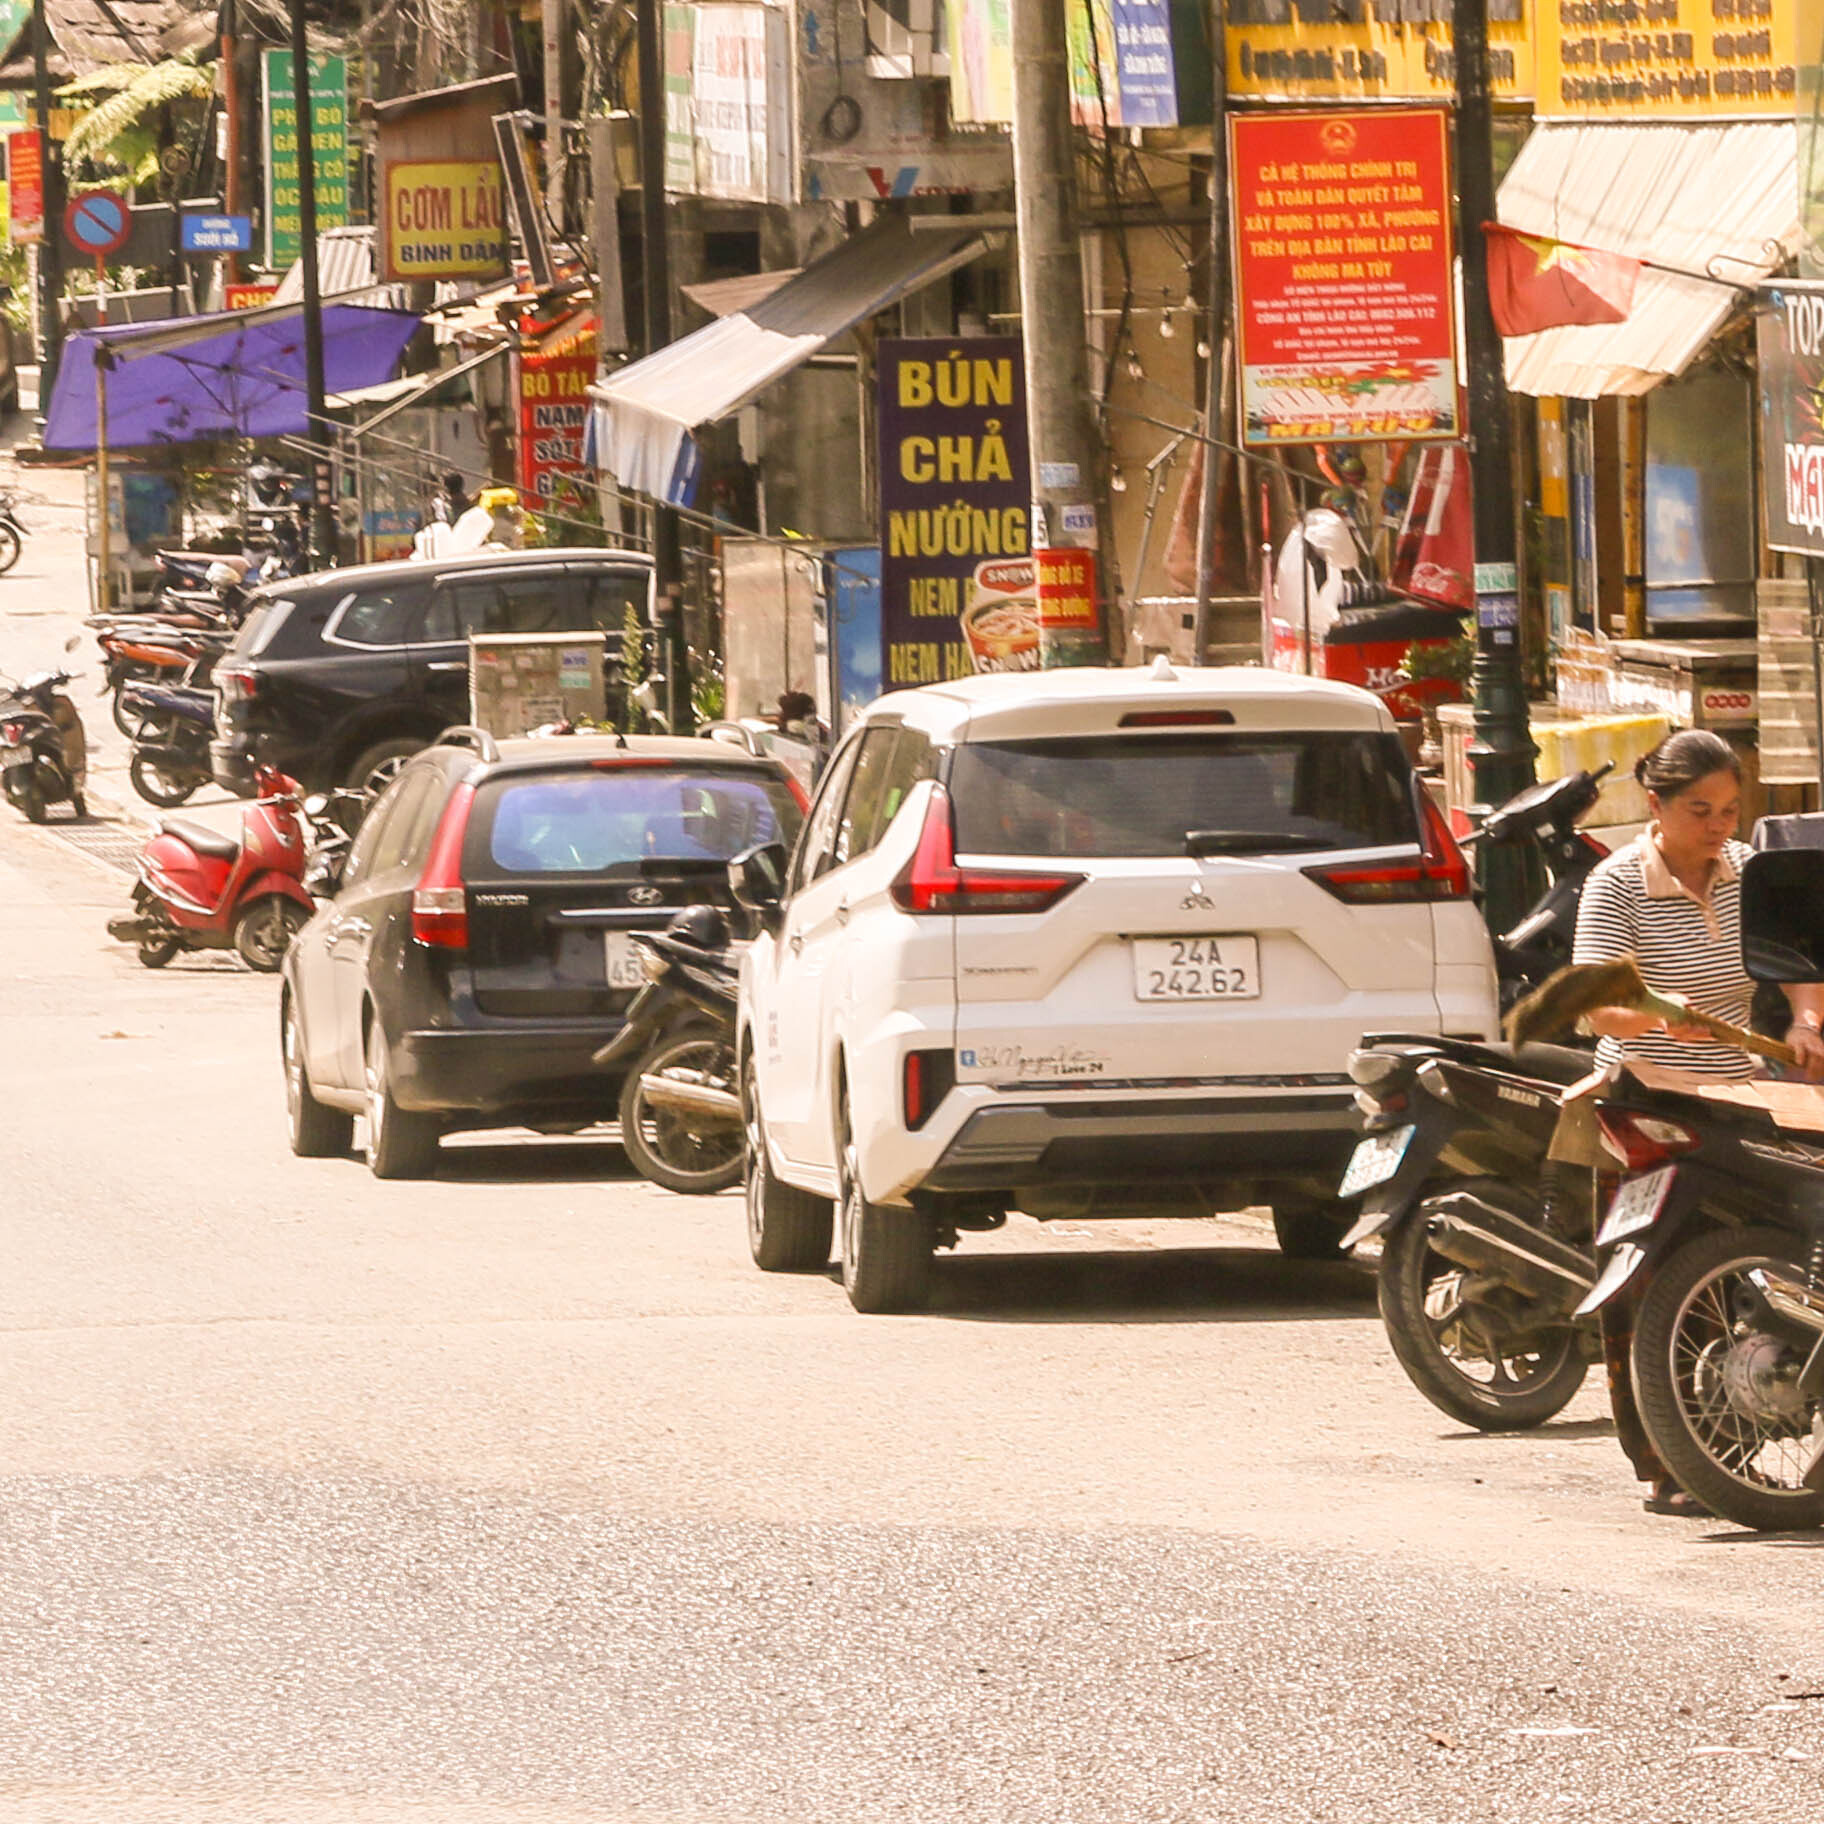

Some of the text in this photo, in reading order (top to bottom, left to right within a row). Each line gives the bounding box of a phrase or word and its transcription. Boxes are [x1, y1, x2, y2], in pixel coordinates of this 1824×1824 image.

[397, 182, 452, 232] CƠM
[400, 240, 453, 264] BÌNH
[897, 349, 1014, 408] BÚN
[899, 419, 1014, 484] CHẢ
[889, 499, 1027, 558] NƯỚNG
[909, 578, 959, 617] NEM
[890, 642, 937, 684] NEM
[1170, 940, 1222, 968] 24A
[1148, 967, 1247, 996] 242.62
